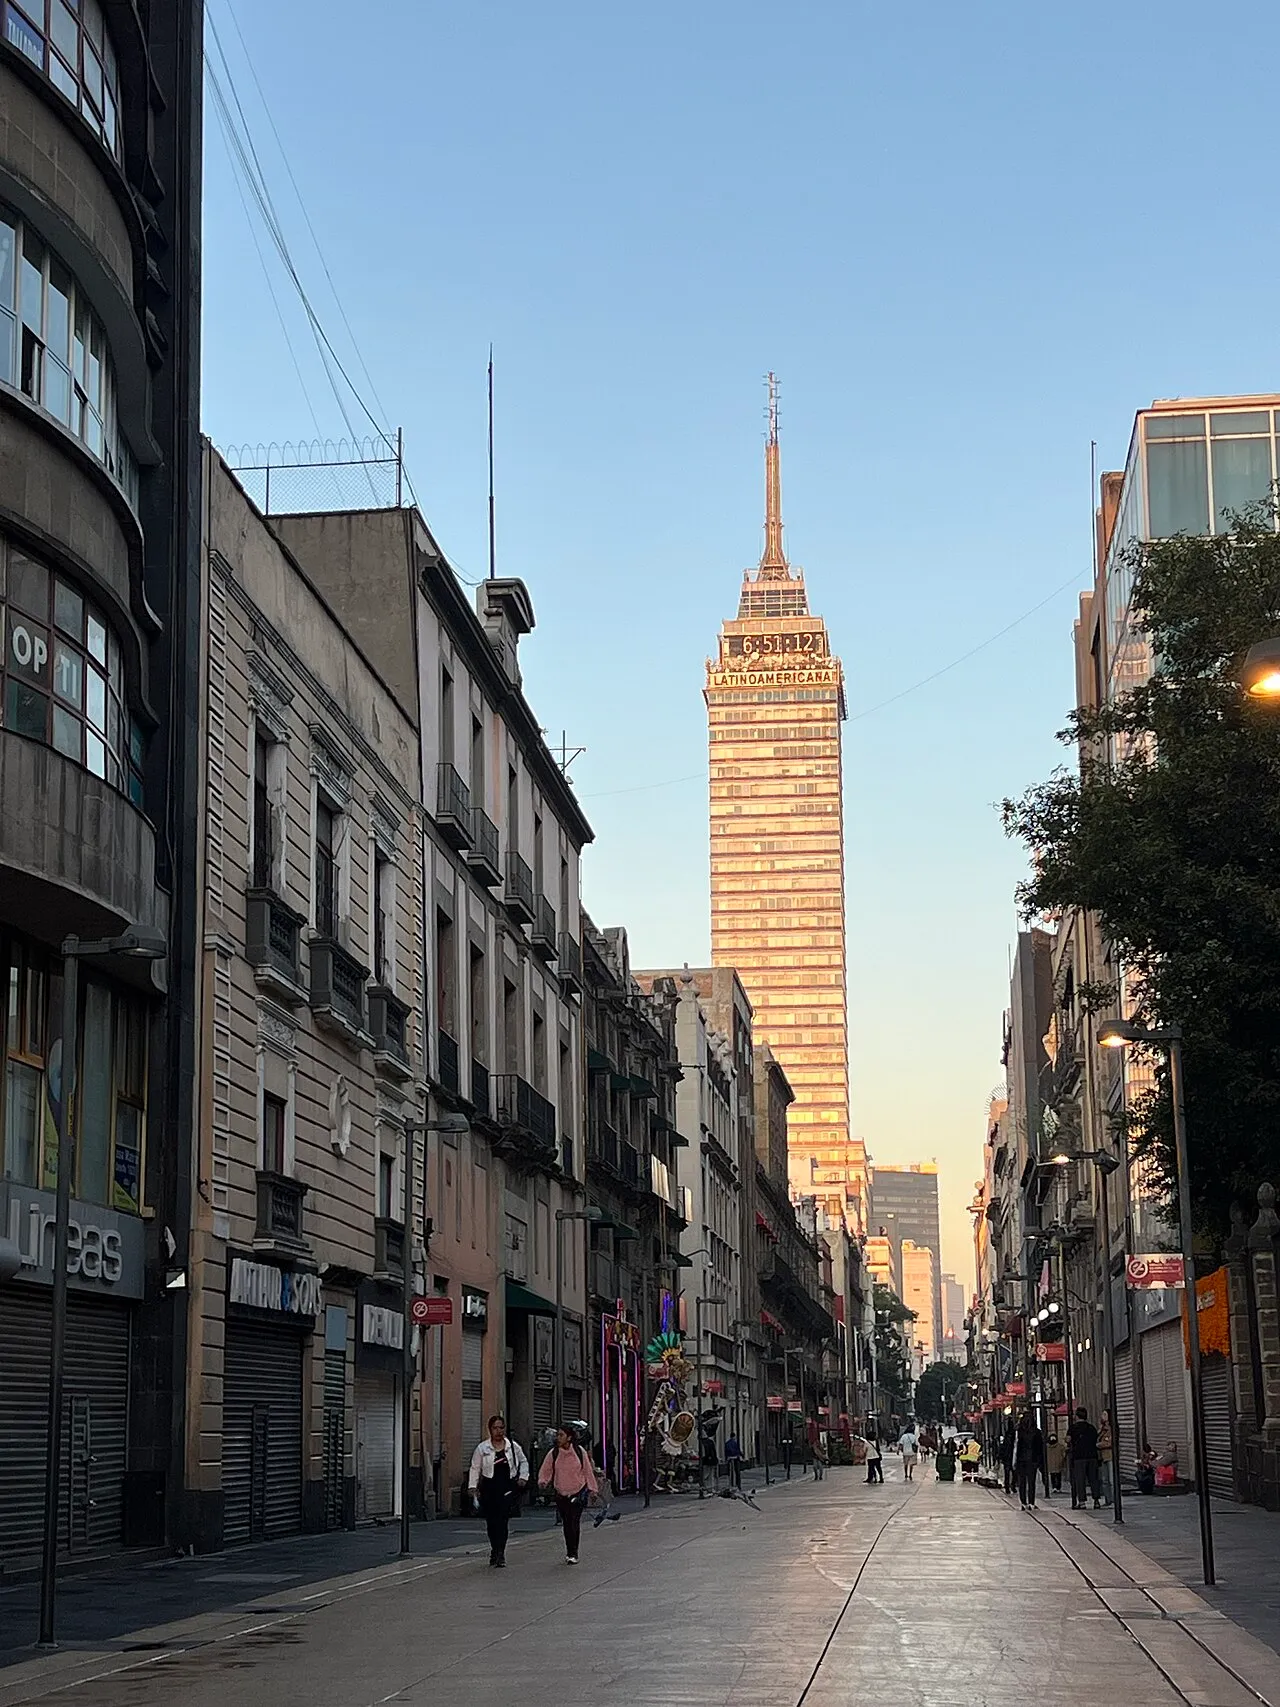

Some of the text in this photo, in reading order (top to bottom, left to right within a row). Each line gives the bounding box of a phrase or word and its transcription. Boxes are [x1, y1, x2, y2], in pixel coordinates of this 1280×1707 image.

[743, 633, 813, 654] 6:51:12
[713, 671, 832, 686] LATINOAMERICANA
[291, 1272, 323, 1316] SONS
